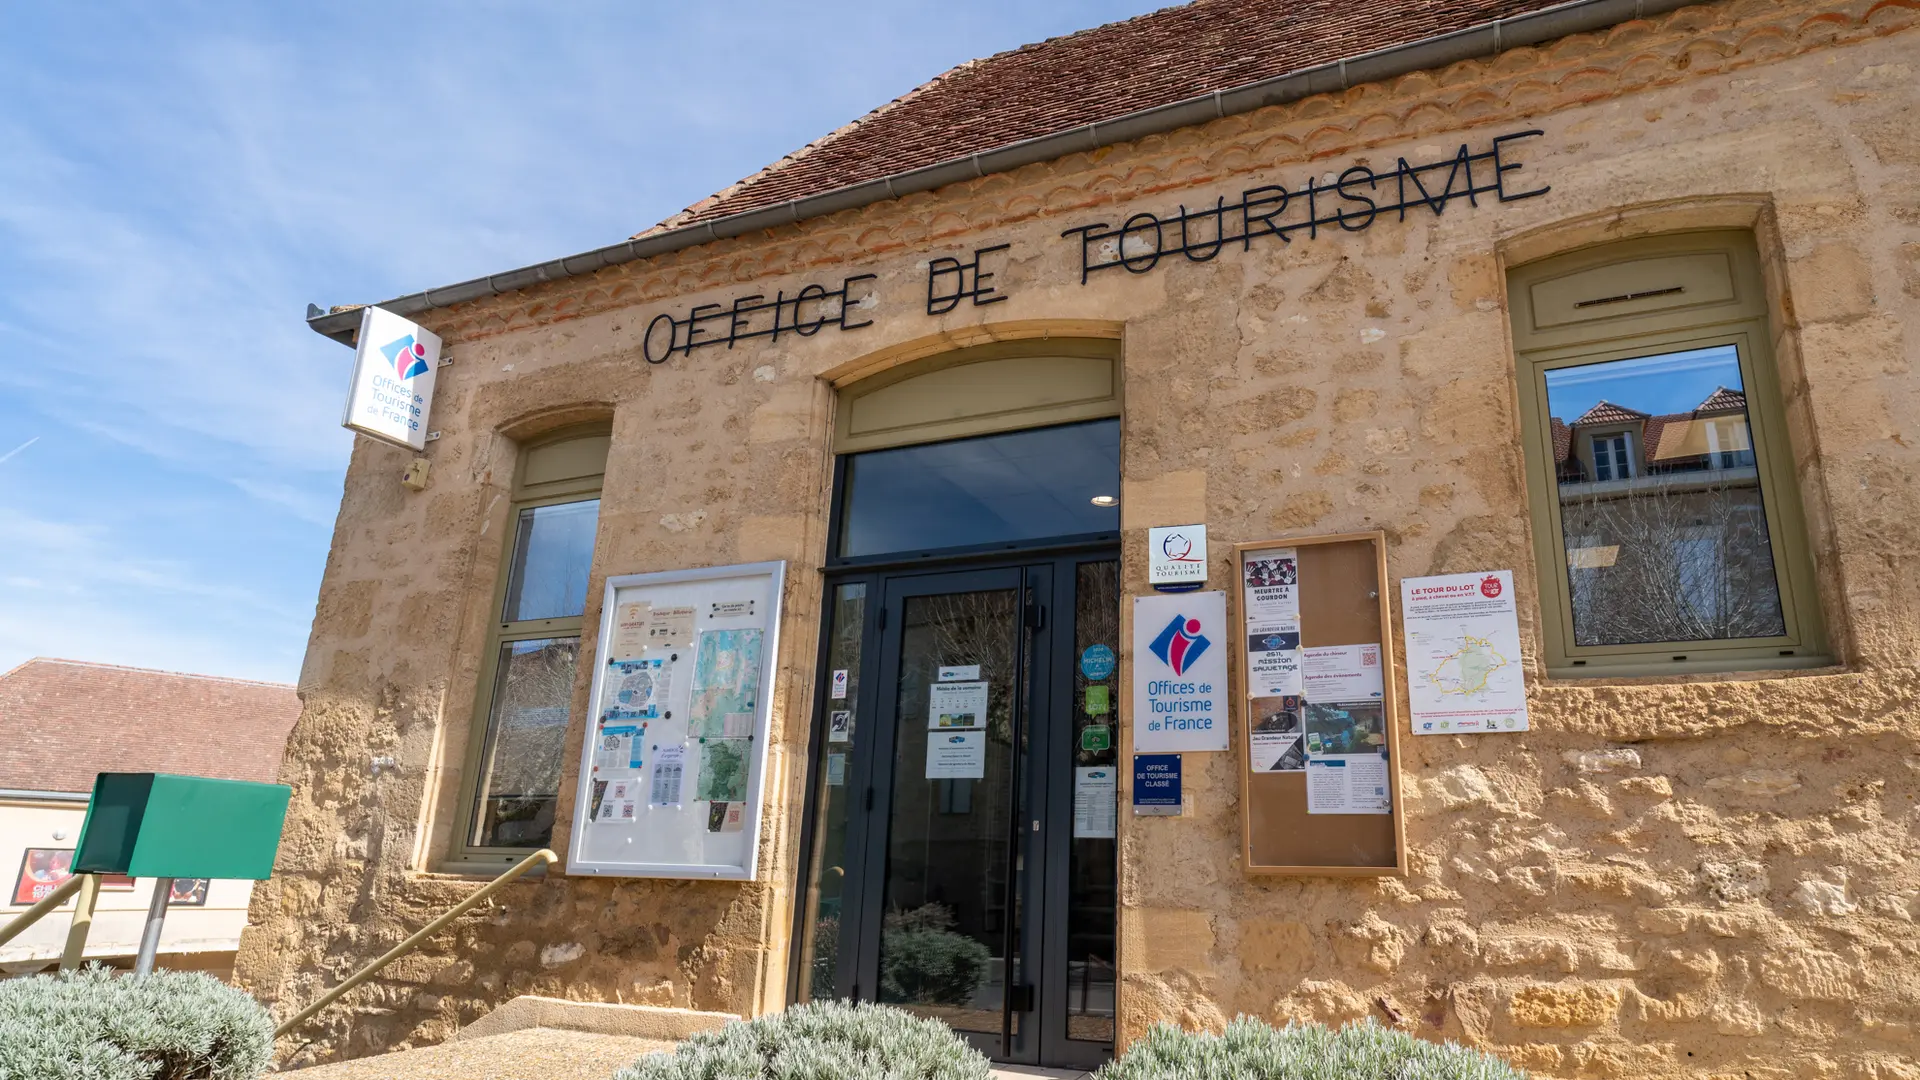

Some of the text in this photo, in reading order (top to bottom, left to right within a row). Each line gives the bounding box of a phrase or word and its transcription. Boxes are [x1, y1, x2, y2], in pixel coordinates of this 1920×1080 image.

[644, 129, 1551, 363] OFFICE DE TOURISME
[372, 374, 423, 404] Offices de
[372, 387, 421, 417] Tourisme
[367, 404, 418, 431] de France
[1148, 680, 1211, 696] Offices de
[1149, 698, 1212, 713] Tourisme
[1148, 716, 1212, 731] de France
